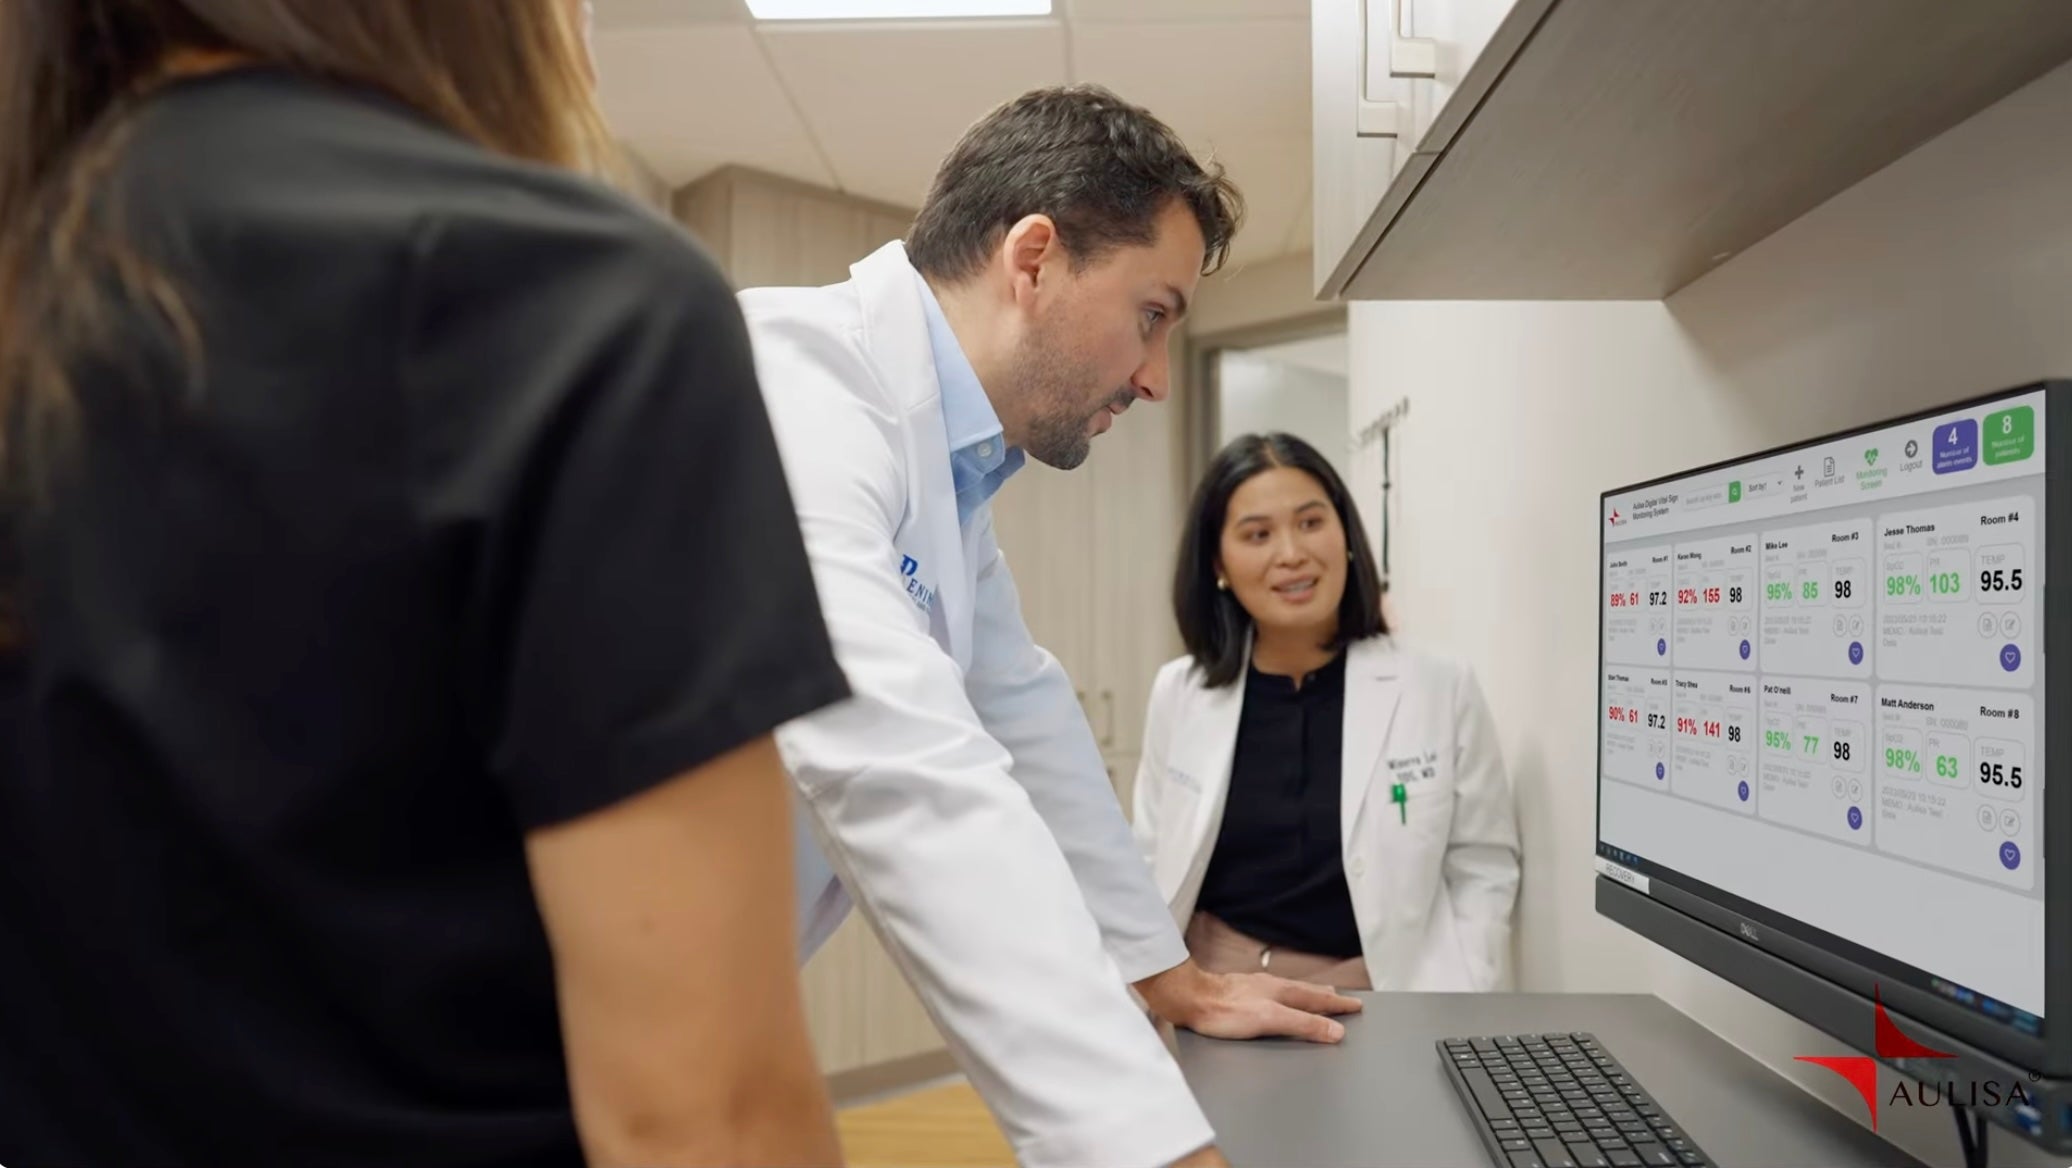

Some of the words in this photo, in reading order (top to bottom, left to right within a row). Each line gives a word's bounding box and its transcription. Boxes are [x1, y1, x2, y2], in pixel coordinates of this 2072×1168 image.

[2002, 415, 2013, 434] 8
[1948, 426, 1958, 445] 4
[1899, 460, 1923, 473] Logout
[1980, 514, 2006, 526] Room
[2008, 511, 2019, 523] #4
[1831, 533, 1850, 543] Room
[1851, 531, 1859, 540] #3
[1884, 525, 1904, 537] Jesse
[1906, 523, 1935, 535] Thomas
[1730, 546, 1744, 554] Room
[1765, 542, 1778, 550] Mike
[1779, 541, 1788, 549] Lee
[1981, 554, 2006, 565] TEMP
[1887, 575, 1921, 596] 98%
[1930, 572, 1960, 594] 103
[1981, 568, 2022, 592] 95.5
[1678, 589, 1697, 604] 92%
[1703, 587, 1720, 603] 155
[1729, 587, 1742, 603] 98
[1803, 582, 1818, 599] 85
[1835, 580, 1851, 598] 98
[1610, 593, 1626, 607] 89%
[1629, 592, 1639, 606] 61
[1649, 591, 1667, 606] 97.2
[1729, 684, 1743, 693] Room
[1764, 685, 1773, 693] Pat
[1831, 693, 1849, 703] Room
[1850, 695, 1858, 704] #7
[1881, 697, 1897, 708] Matt
[1897, 698, 1935, 712] Anderson
[1609, 706, 1625, 722] 90%
[1629, 709, 1638, 724] 61
[1980, 706, 2006, 719] Room
[2007, 709, 2020, 720] #8
[1648, 713, 1665, 730] 97.2
[1677, 717, 1697, 735] 91%
[1704, 720, 1720, 738] 141
[1728, 725, 1741, 743] 98
[1765, 730, 1791, 751] 95%
[1803, 736, 1819, 754] 77
[1834, 741, 1850, 761] 98
[1885, 748, 1920, 773] 98%
[1936, 755, 1958, 779] 63
[1980, 762, 2022, 789] 95.5
[1606, 863, 1635, 884] RECOVERY
